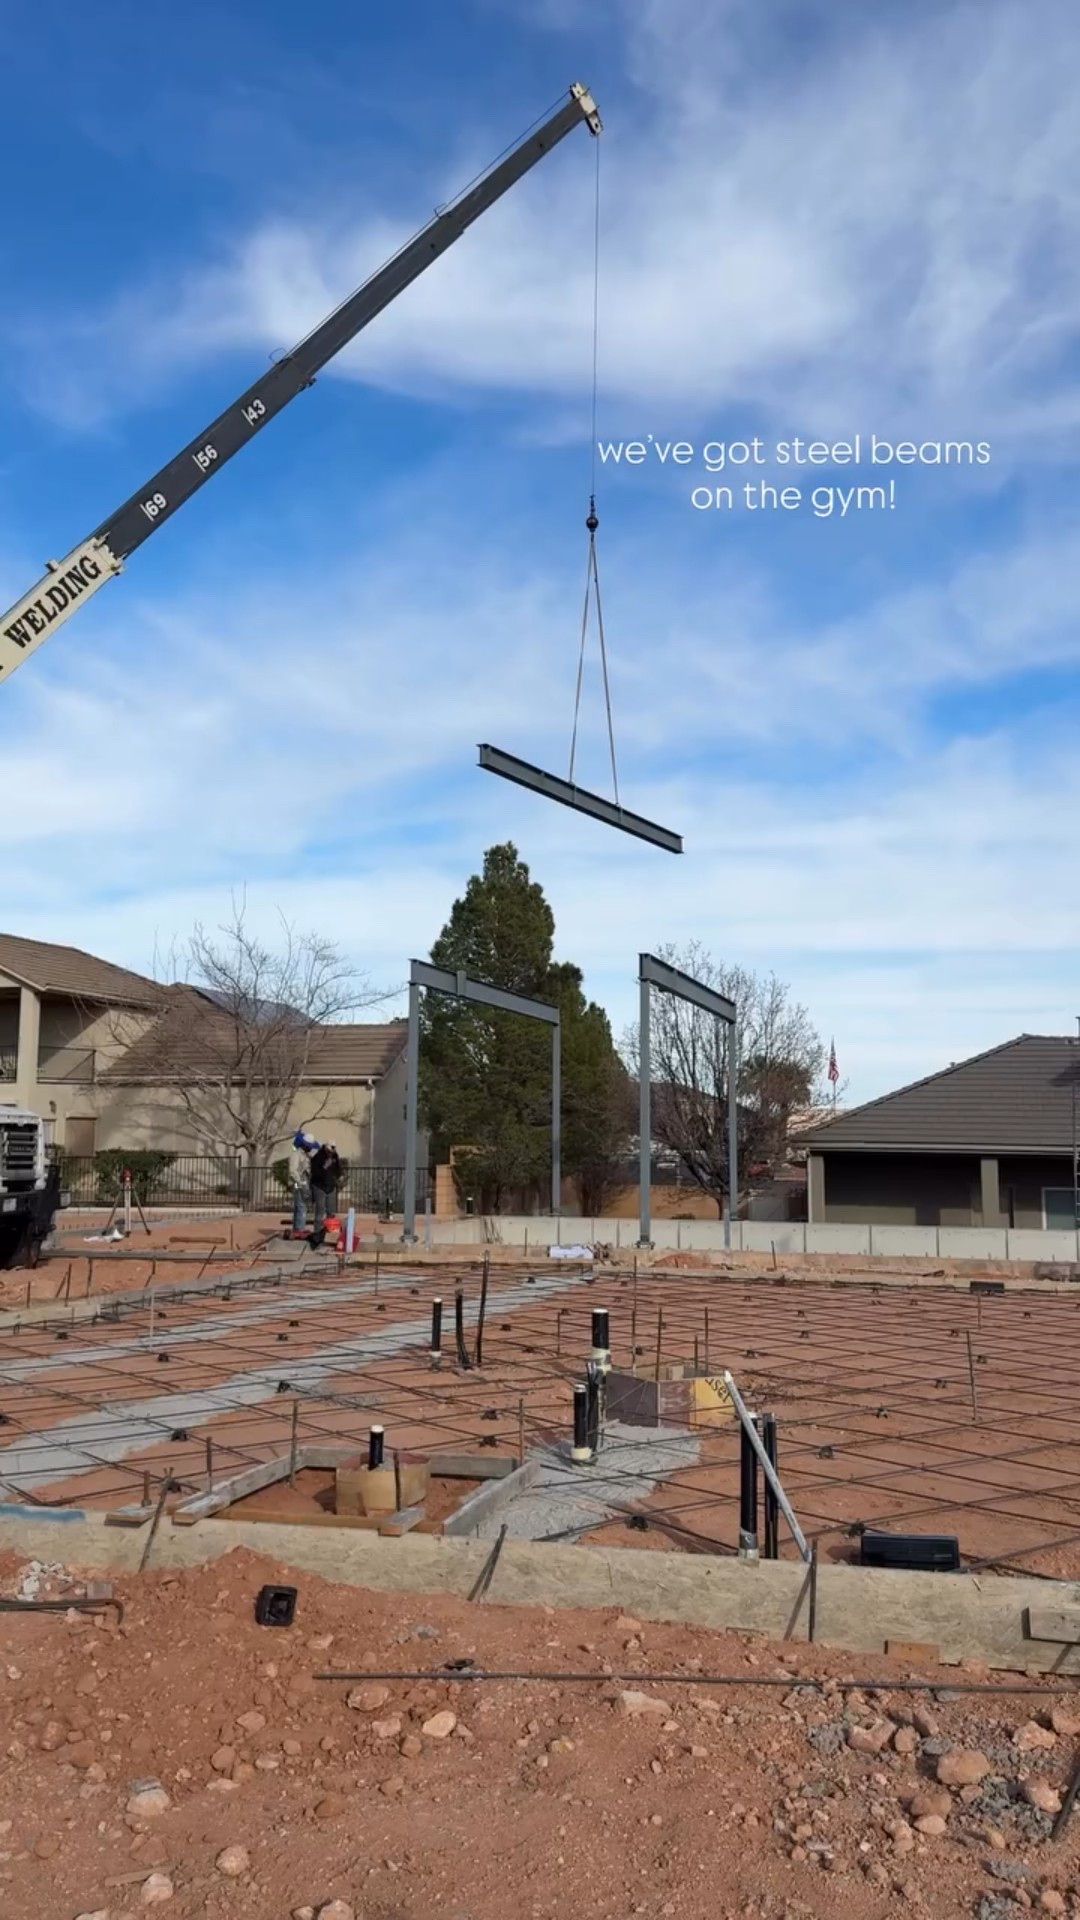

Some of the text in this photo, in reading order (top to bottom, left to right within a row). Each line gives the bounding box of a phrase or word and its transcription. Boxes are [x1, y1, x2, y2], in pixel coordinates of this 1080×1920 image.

[246, 399, 266, 422] 43
[197, 444, 218, 468] 56
[145, 492, 167, 517] 69
[3, 555, 102, 649] WELDING
